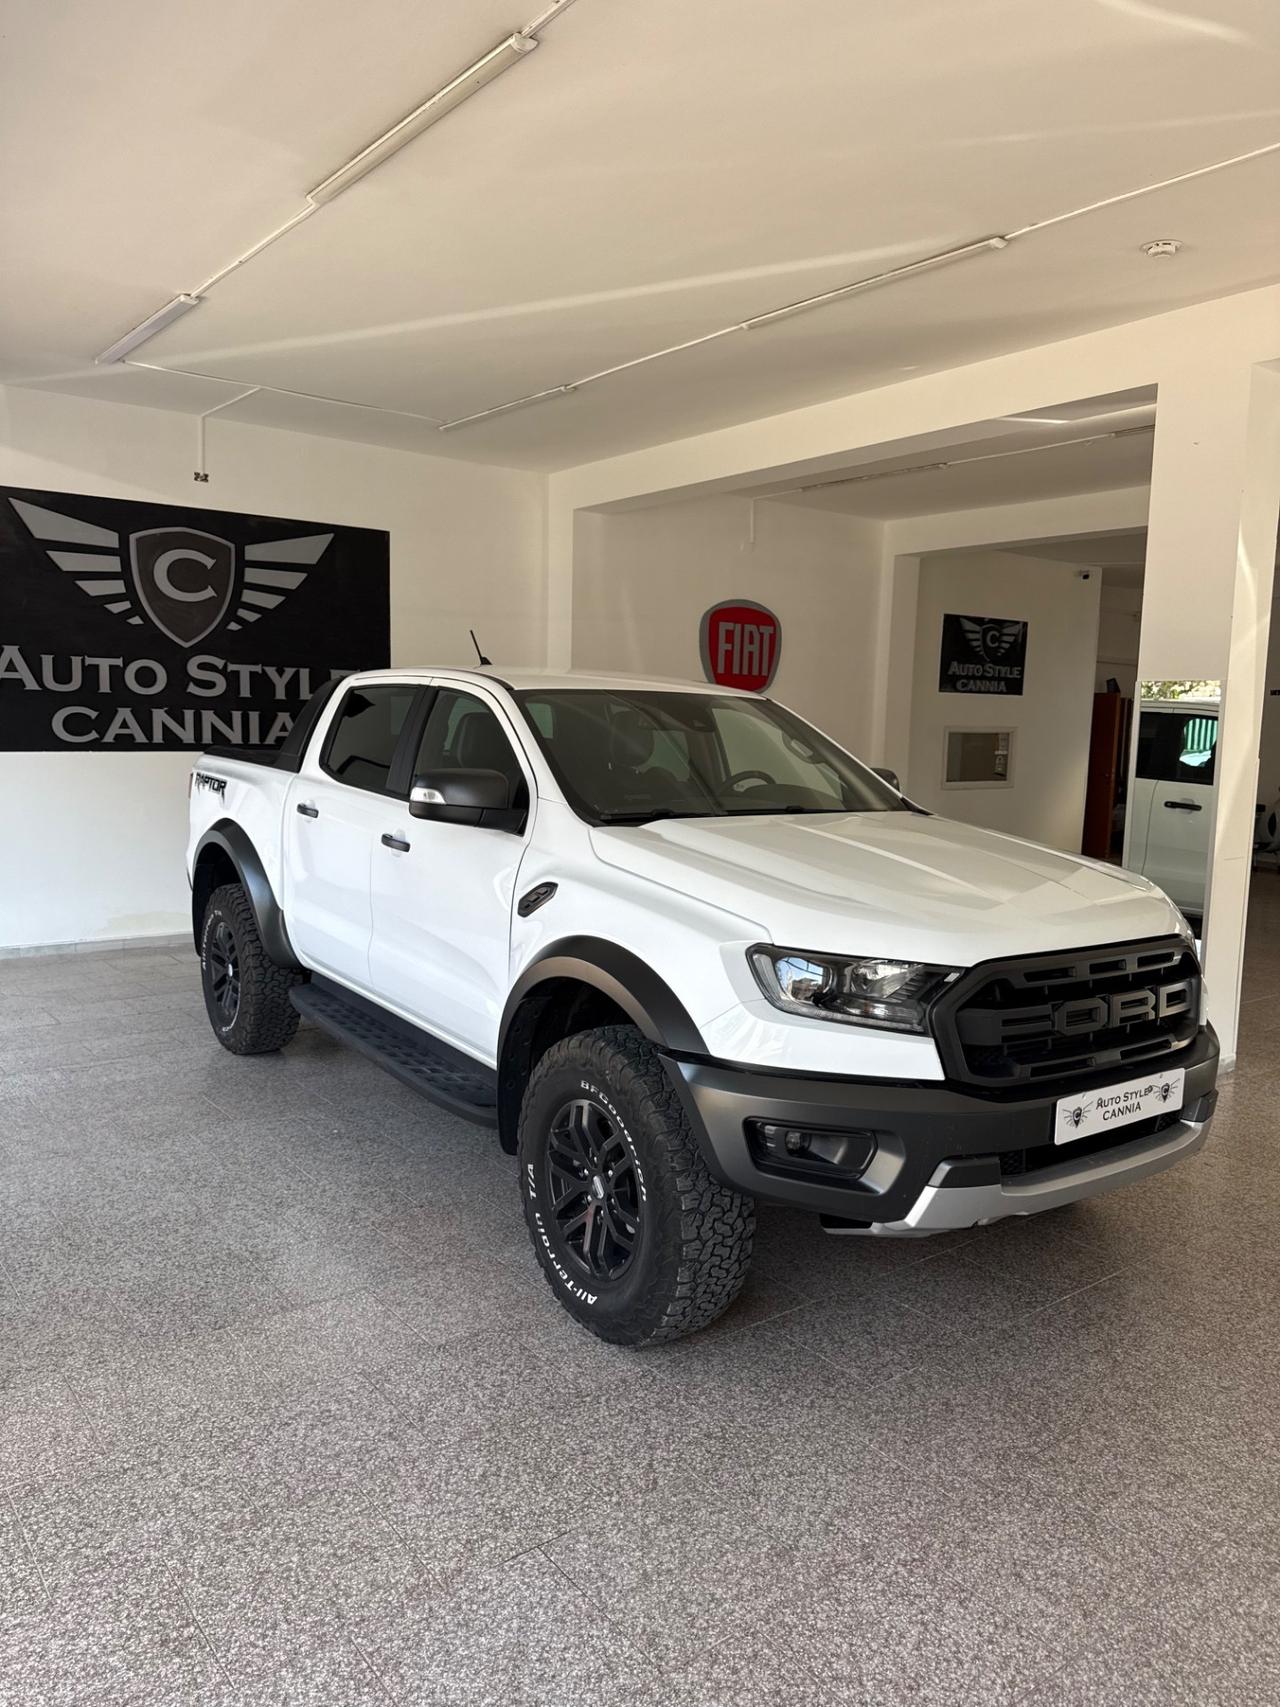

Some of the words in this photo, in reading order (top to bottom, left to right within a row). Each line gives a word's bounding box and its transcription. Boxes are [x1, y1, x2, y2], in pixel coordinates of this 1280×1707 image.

[153, 548, 218, 602] C
[717, 621, 775, 677] FIAT
[0, 645, 168, 695] AUTO
[186, 655, 361, 700] STYL
[948, 661, 983, 676] AUTO
[984, 663, 1022, 678] STYLE
[956, 679, 1007, 692] CANNIA
[51, 706, 296, 744] CANNIA
[195, 772, 227, 800] RAPTOR
[990, 980, 1193, 1047] FORD
[1096, 1096, 1121, 1110] AUTO
[1123, 1086, 1150, 1102] STYLE
[1103, 1101, 1141, 1120] CANNIA
[527, 1163, 537, 1200] T/A
